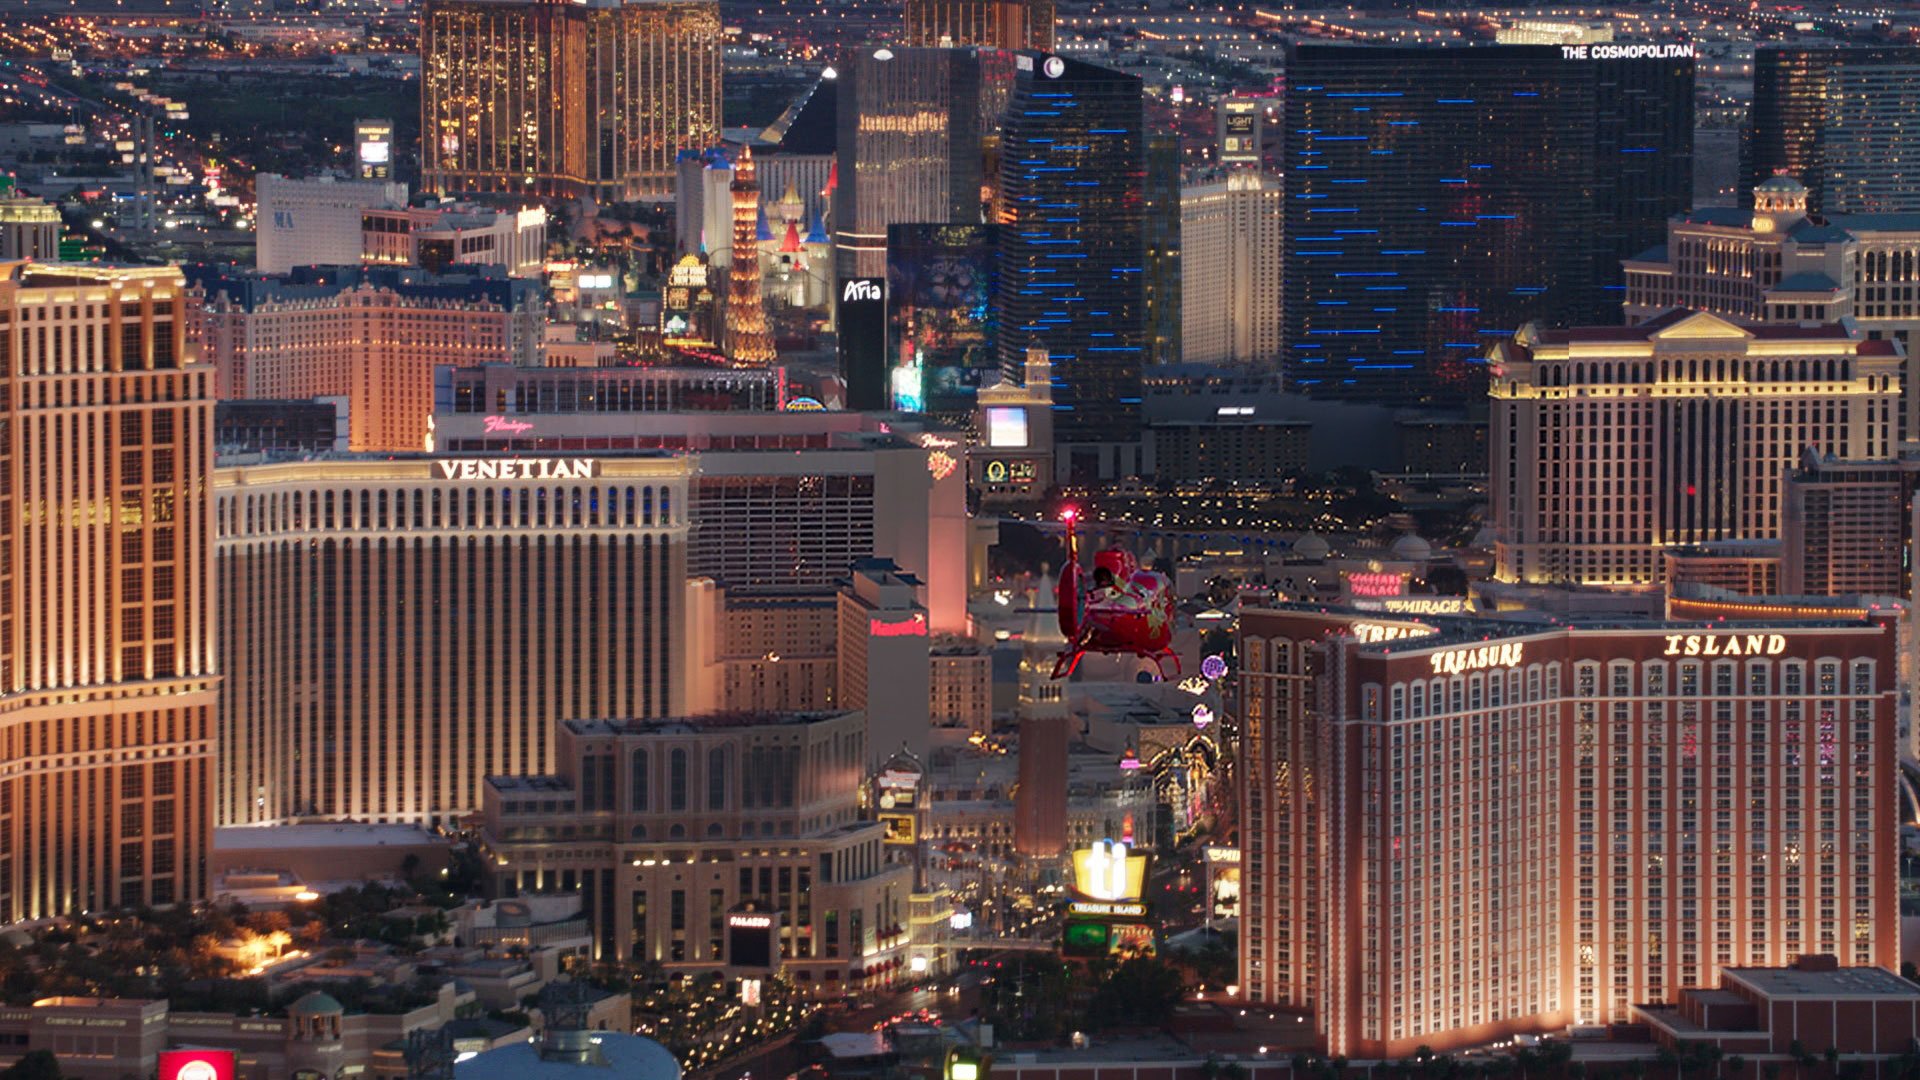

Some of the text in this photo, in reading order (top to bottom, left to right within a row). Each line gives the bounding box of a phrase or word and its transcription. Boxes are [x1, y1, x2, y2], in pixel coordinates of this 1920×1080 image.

[1561, 45, 1694, 59] THE COSMOPOLITAN
[843, 280, 882, 302] Aria
[438, 459, 595, 480] VENETIAN
[1396, 600, 1461, 615] MIRAGE
[1664, 634, 1787, 656] ISLAND
[1430, 642, 1524, 675] TREASURE
[1074, 902, 1143, 915] TREASURE ISLAND
